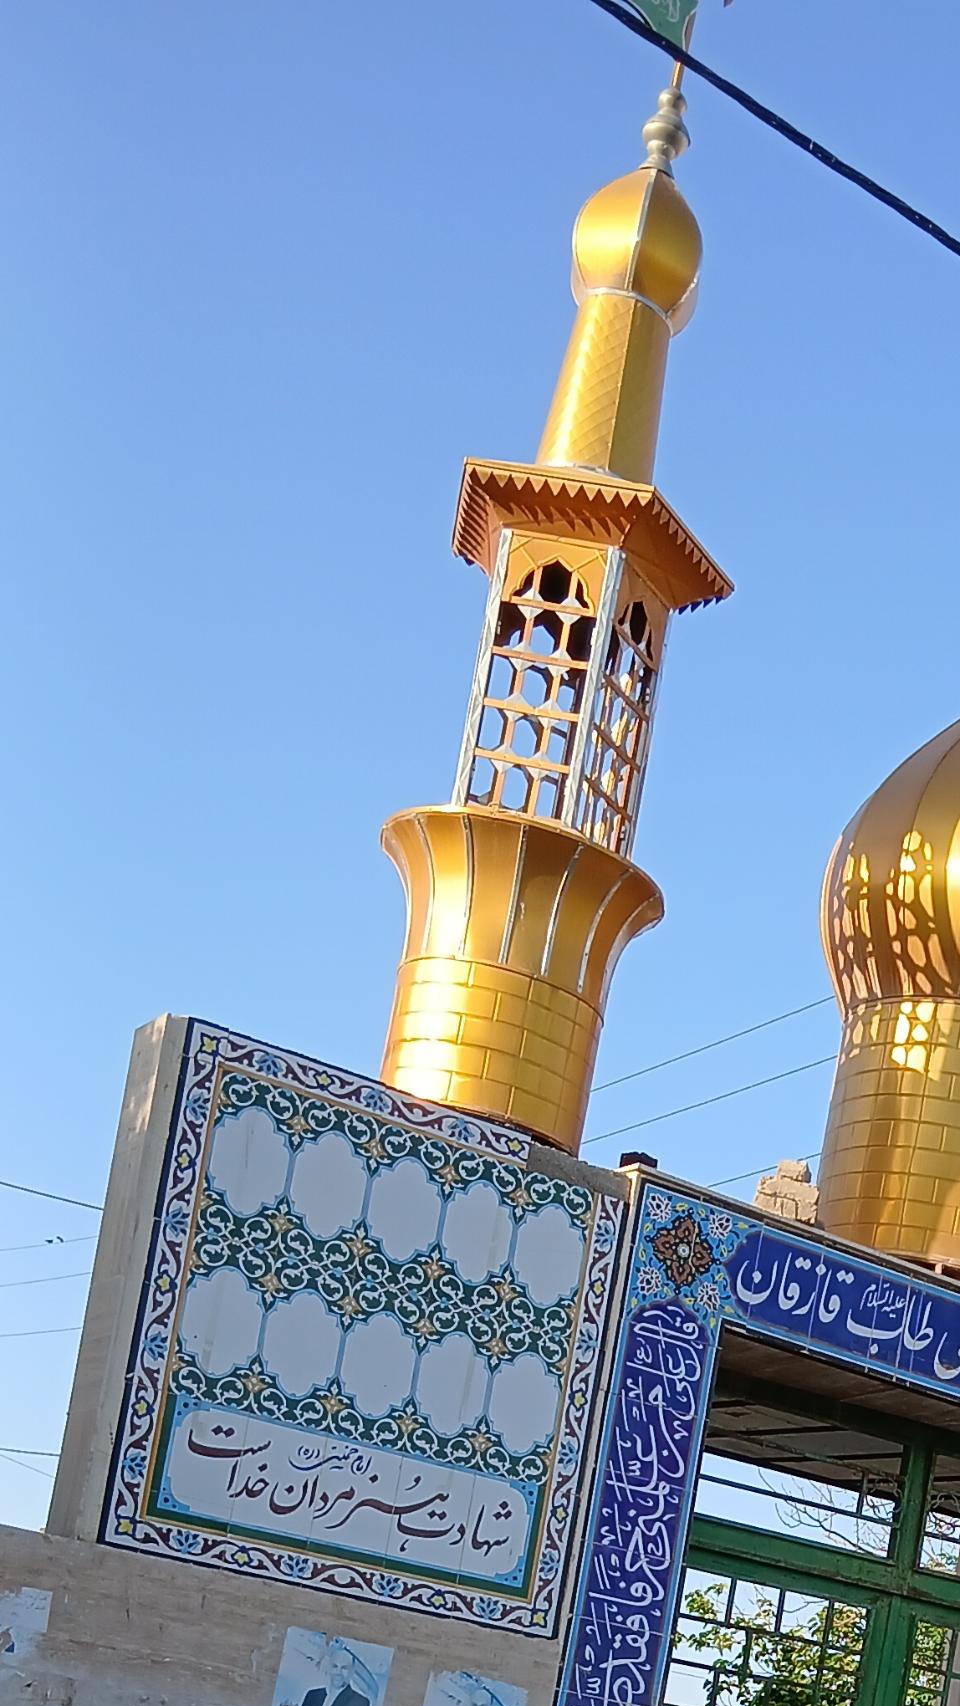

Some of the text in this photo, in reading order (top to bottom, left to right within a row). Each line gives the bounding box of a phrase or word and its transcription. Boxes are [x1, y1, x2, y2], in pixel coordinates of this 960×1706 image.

[736, 1252, 855, 1323] قازقان
[846, 1285, 934, 1354] طالب
[187, 1425, 512, 1557] شهادت هنر مردان خداست
